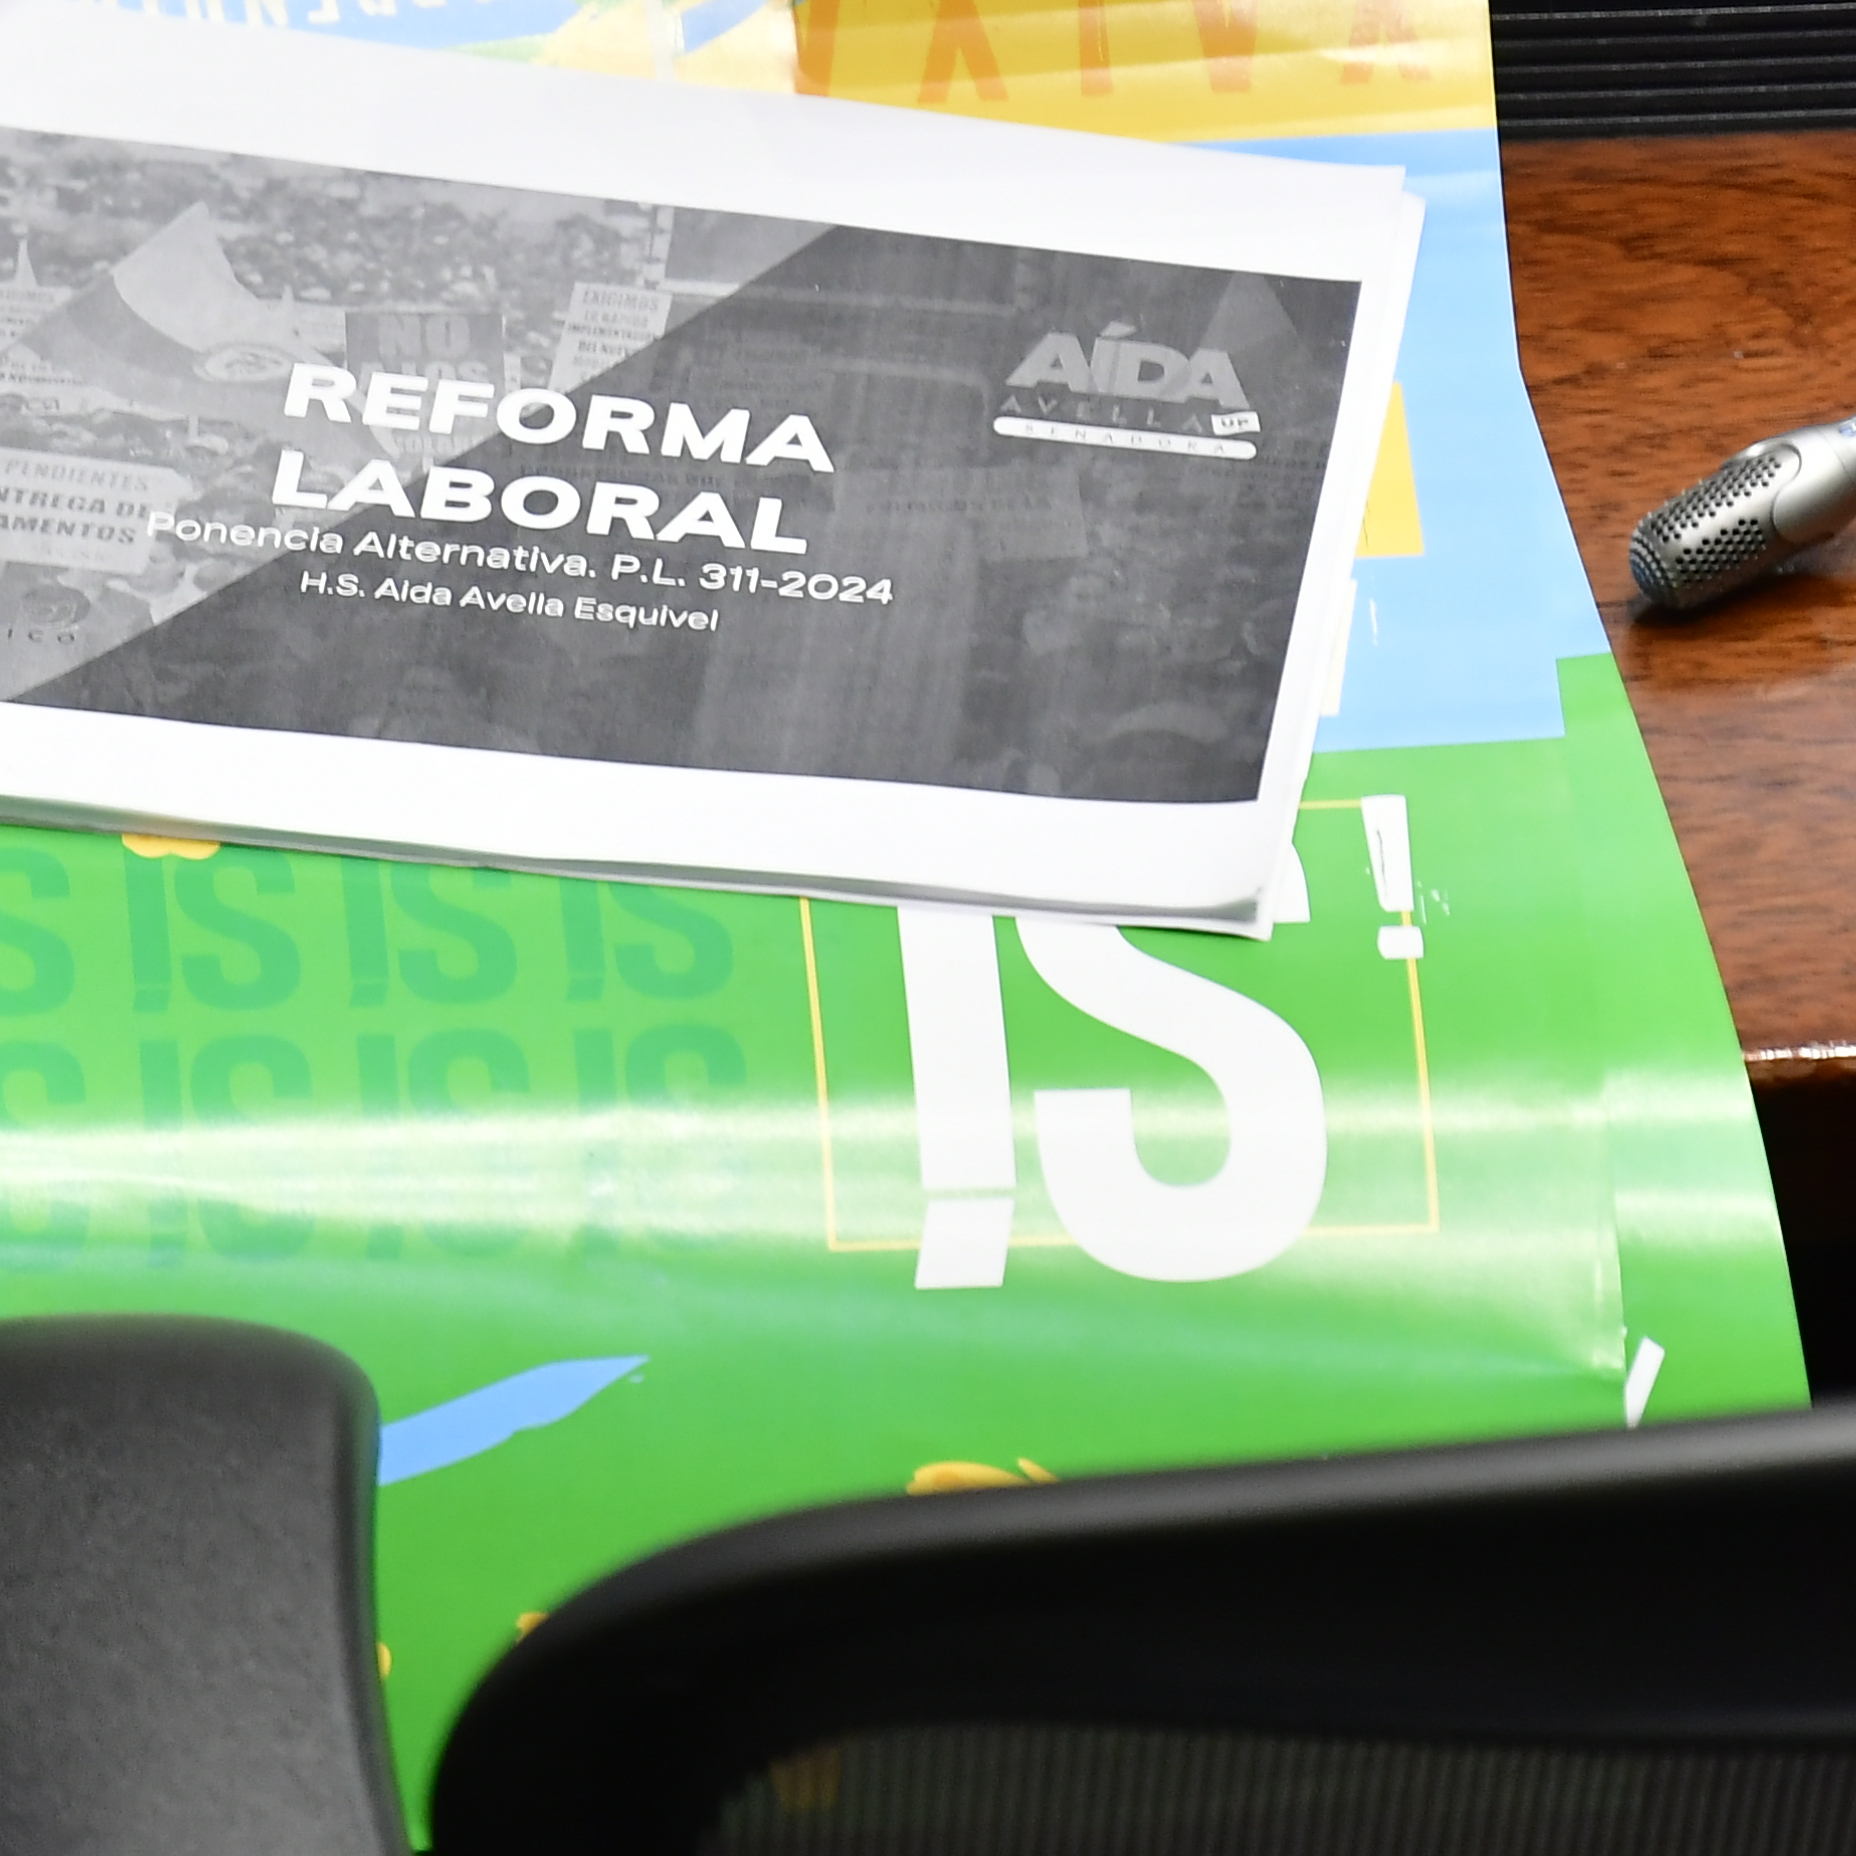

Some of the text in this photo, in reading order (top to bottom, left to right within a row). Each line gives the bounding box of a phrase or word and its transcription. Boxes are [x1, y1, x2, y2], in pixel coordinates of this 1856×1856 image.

[1005, 320, 1251, 411] AÍDA
[284, 362, 836, 474] REFORMA
[1000, 394, 1204, 434] AVELLA
[1024, 423, 1227, 455] SENADORA
[114, 501, 150, 520] DE
[270, 448, 808, 555] LABORAL
[146, 510, 344, 556] Ponencia
[352, 531, 598, 580] Alternativa.
[611, 553, 687, 588] P.L.
[698, 562, 894, 606] 311-2024
[300, 569, 720, 633] H.S. Aida Avella Esquivel
